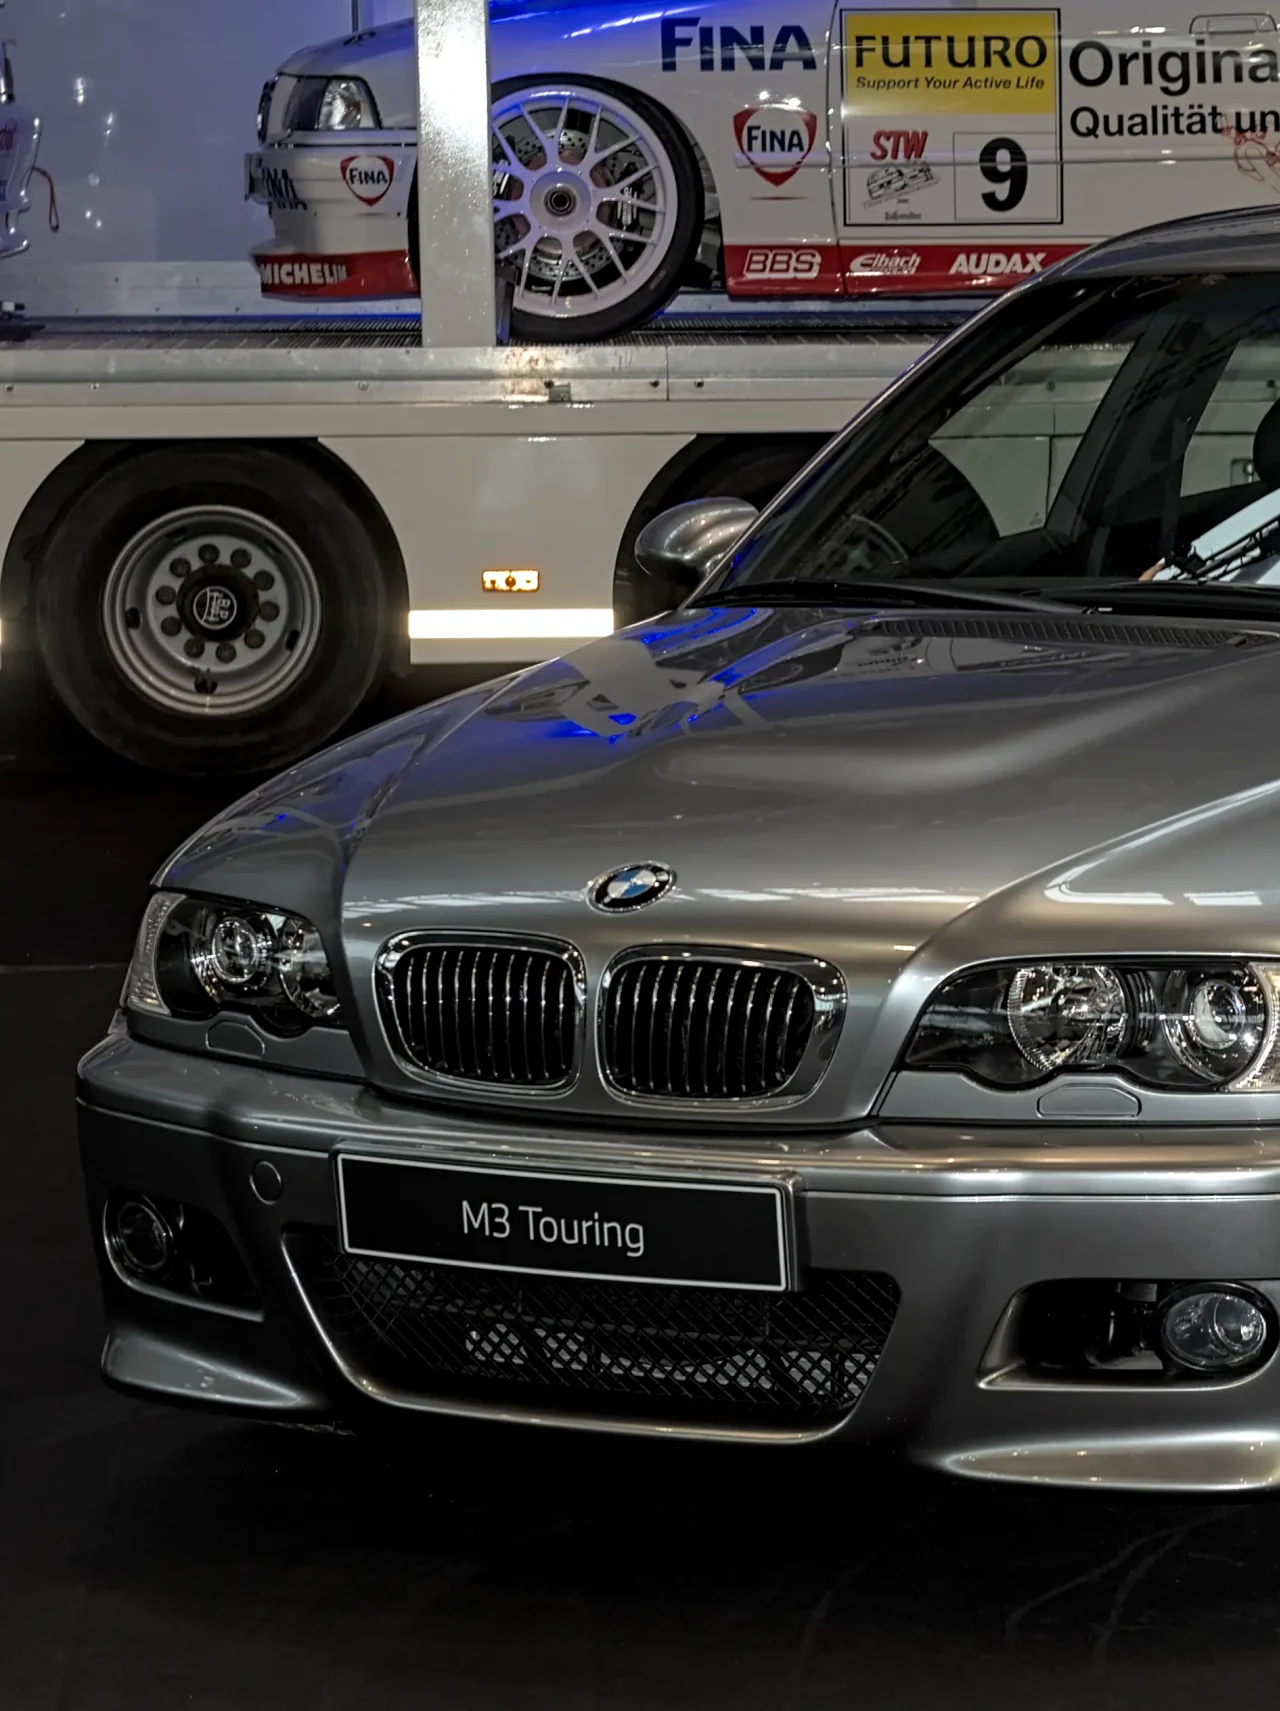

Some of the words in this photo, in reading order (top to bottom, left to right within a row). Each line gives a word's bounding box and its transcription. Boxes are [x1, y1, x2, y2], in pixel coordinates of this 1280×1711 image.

[661, 17, 817, 72] FINA
[854, 35, 1048, 69] FUTURO
[856, 76, 919, 91] Support
[924, 76, 959, 89] Your
[962, 76, 1012, 89] Active
[1015, 75, 1045, 89] Life
[1069, 104, 1223, 139] Qualität
[746, 124, 804, 152] FINA
[869, 130, 928, 160] STW
[348, 167, 388, 185] FINA
[978, 136, 1029, 213] 9
[259, 262, 348, 285] MICHELIN
[744, 249, 822, 280] BBS
[948, 252, 1047, 275] AUDAX
[461, 1199, 510, 1238] M3
[518, 1205, 645, 1257] Touring
